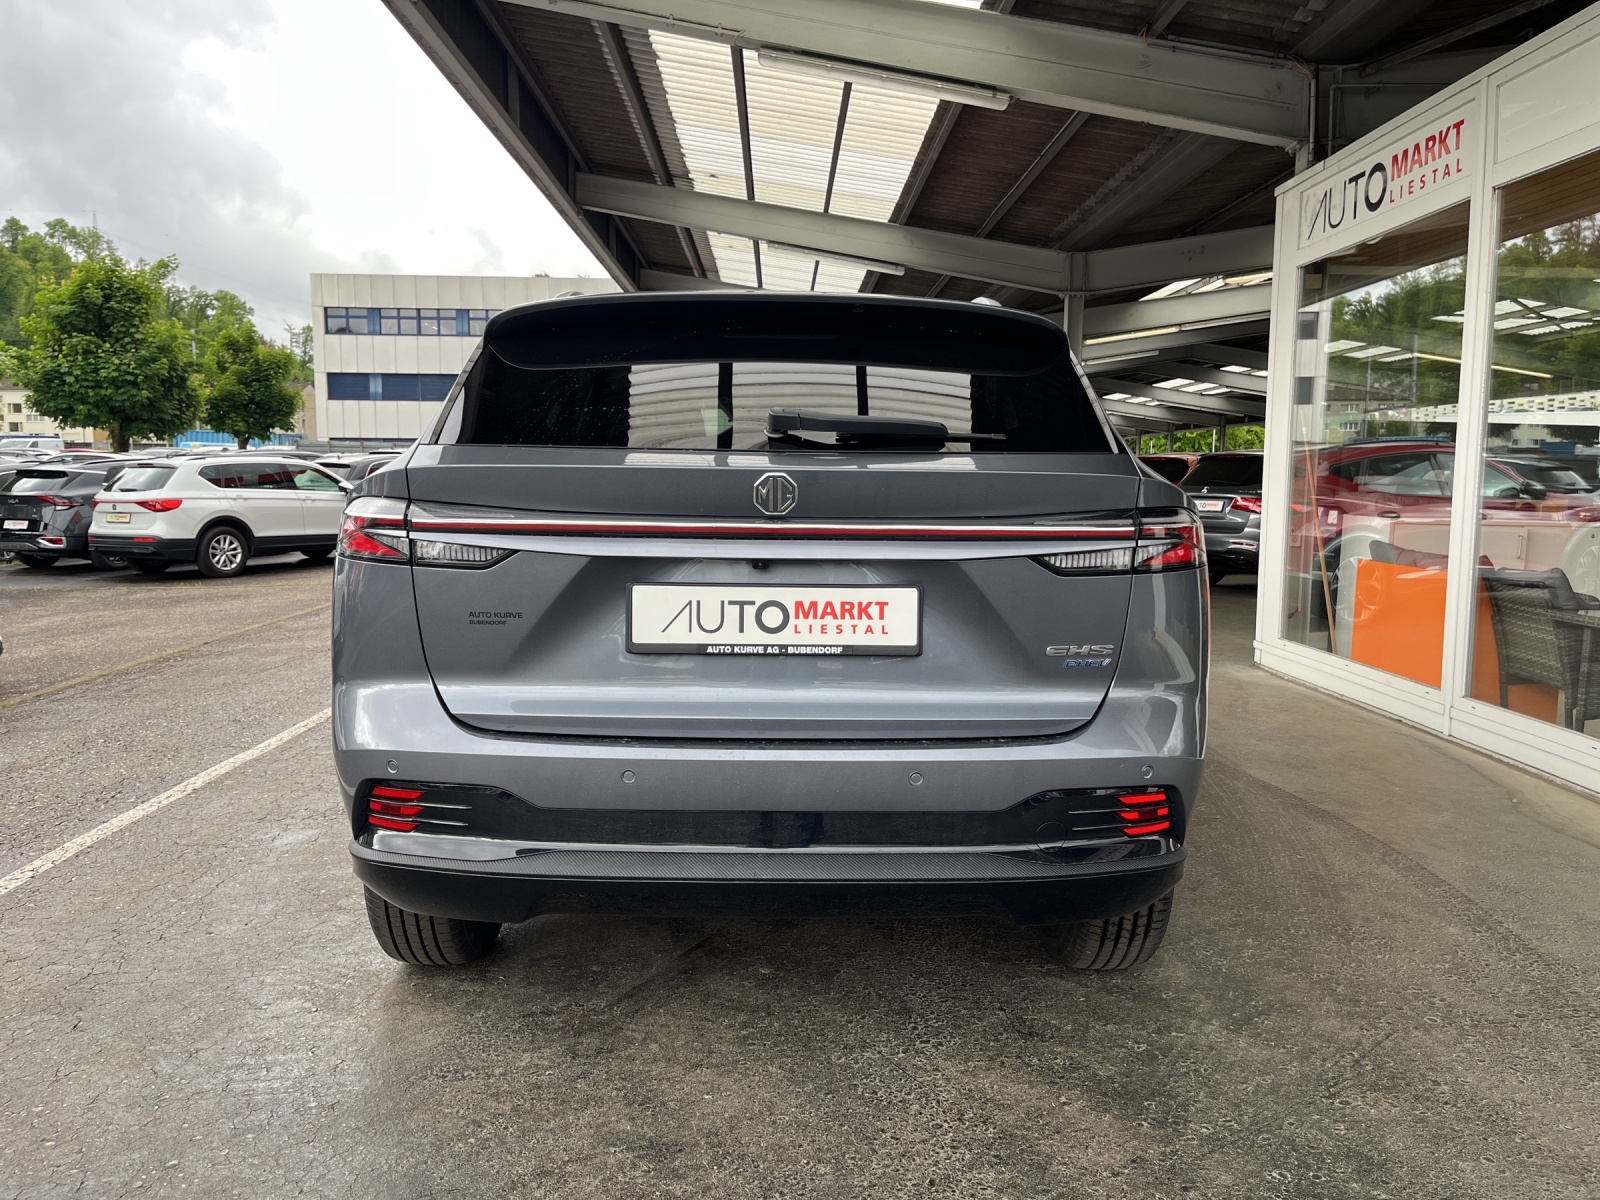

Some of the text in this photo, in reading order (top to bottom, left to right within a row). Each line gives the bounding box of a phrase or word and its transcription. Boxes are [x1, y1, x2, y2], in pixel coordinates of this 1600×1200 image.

[1307, 119, 1465, 240] AUTO MARKT
[1389, 158, 1463, 204] LIESTAL
[757, 476, 794, 512] MG
[493, 611, 523, 619] KURVE
[660, 599, 889, 635] AUTO MARKT
[793, 624, 889, 635] LIESTAL
[706, 645, 732, 653] AUTO
[733, 645, 765, 654] KURVE
[766, 645, 780, 653] AG
[787, 646, 843, 654] BUBENDORF
[1045, 644, 1115, 657] EHS
